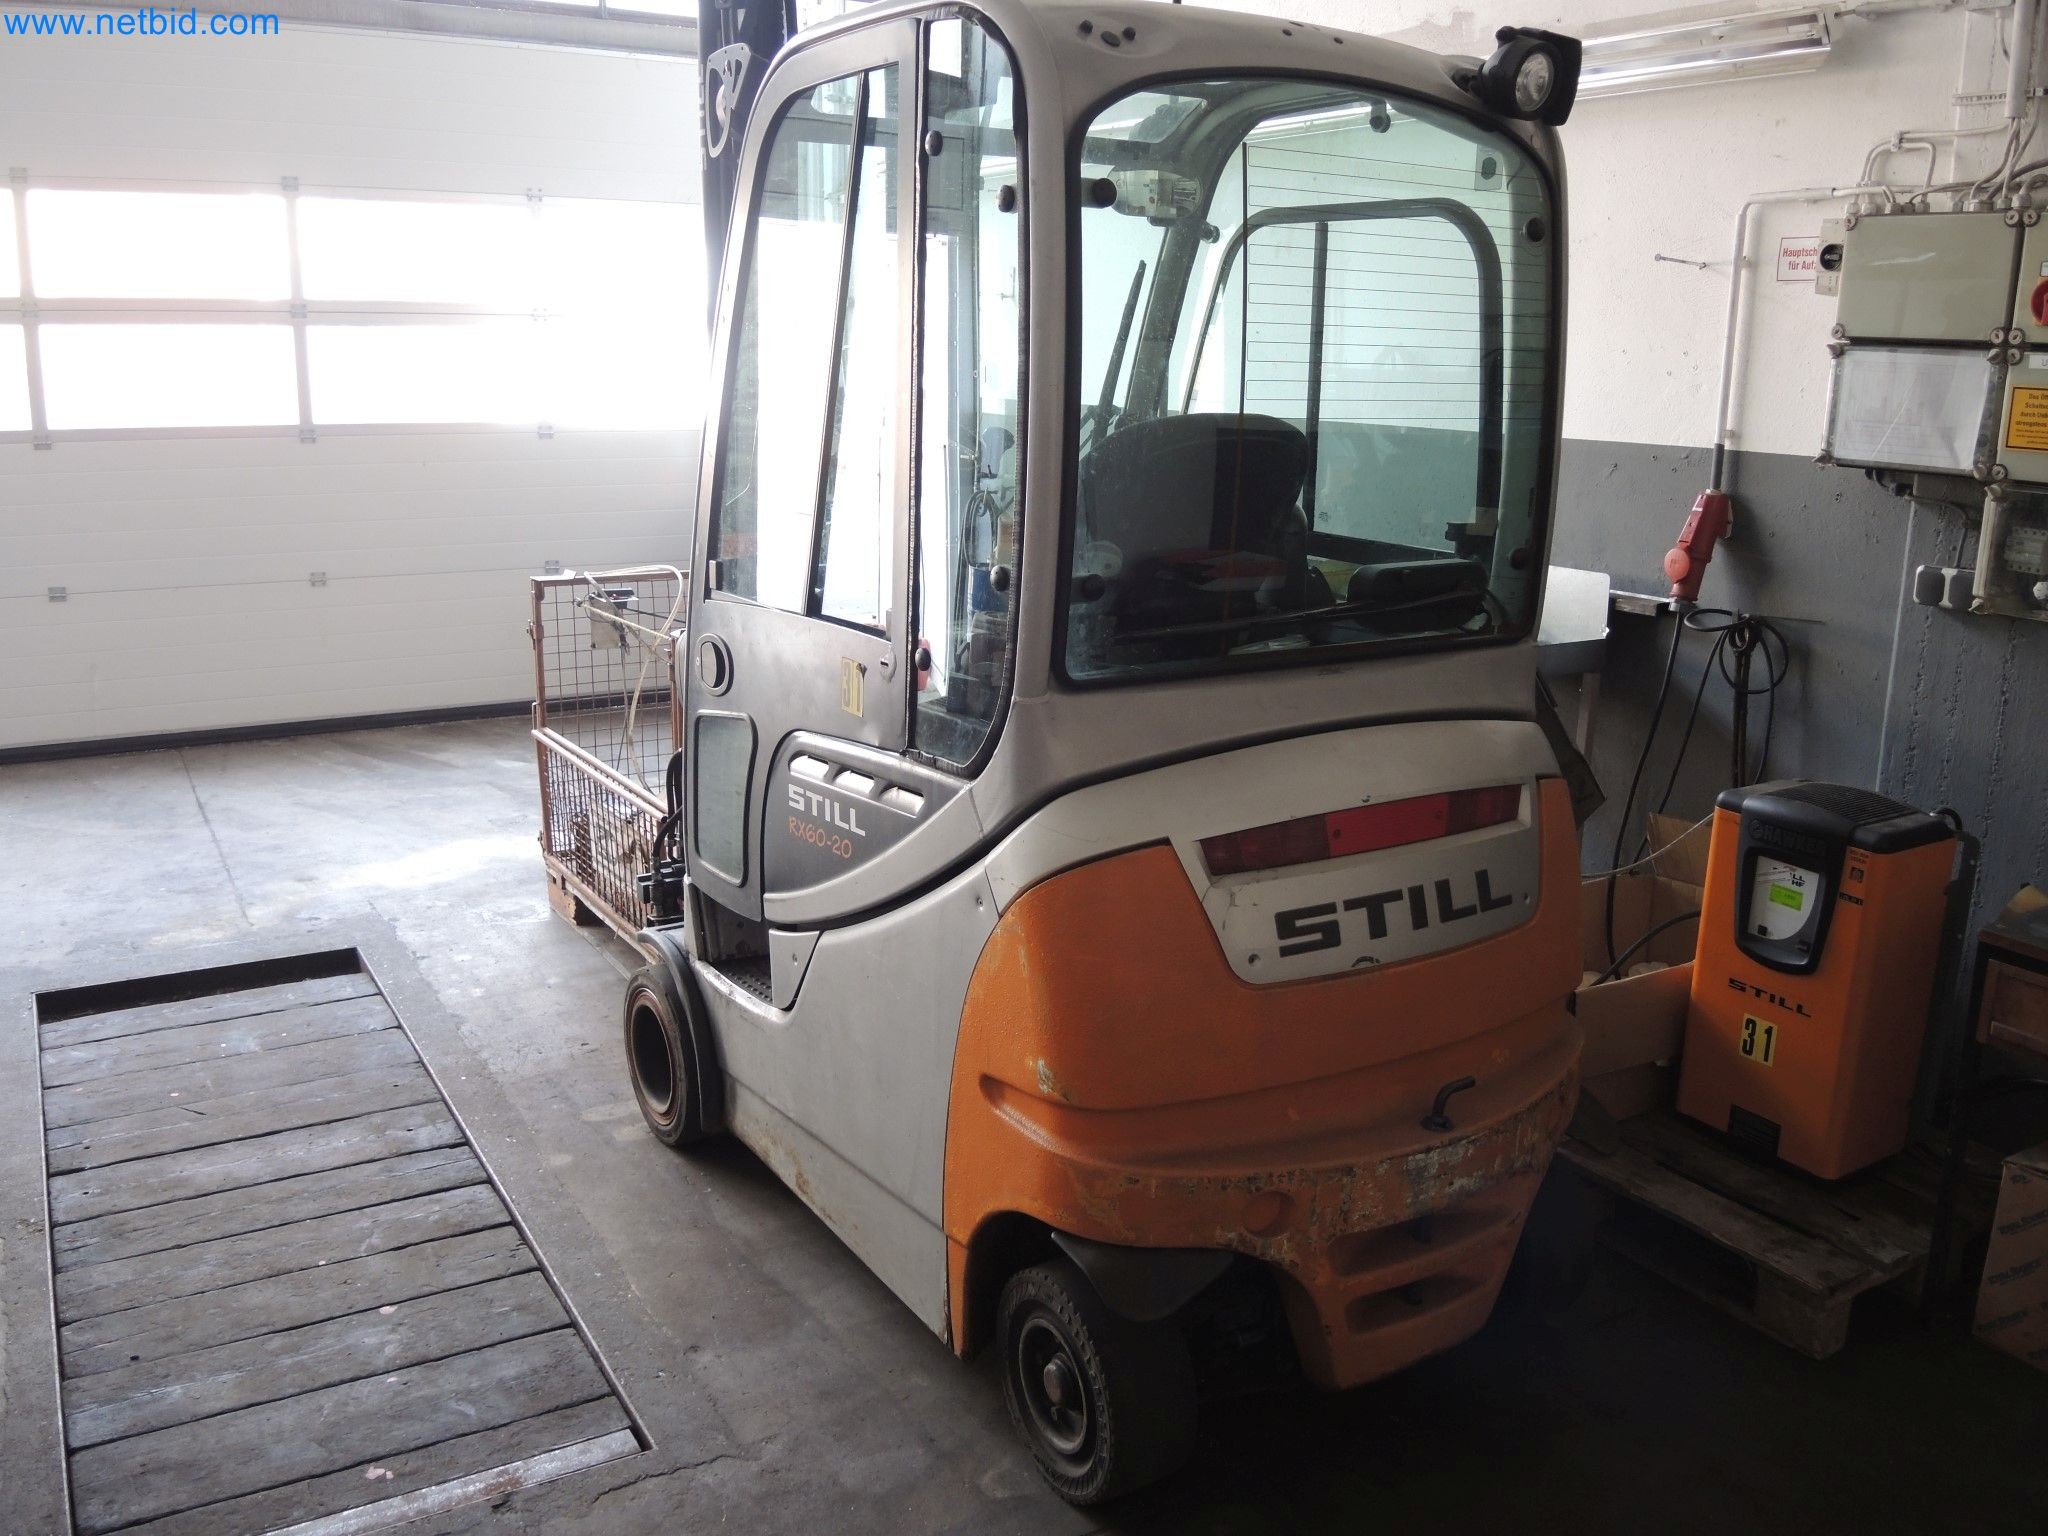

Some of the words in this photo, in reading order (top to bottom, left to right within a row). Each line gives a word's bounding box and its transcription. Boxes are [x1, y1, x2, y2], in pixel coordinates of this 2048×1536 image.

[789, 784, 865, 836] STILL
[789, 816, 852, 859] RX60-20
[1275, 869, 1512, 958] STILL
[1728, 977, 1812, 1017] STILL
[1742, 1018, 1773, 1062] 31
